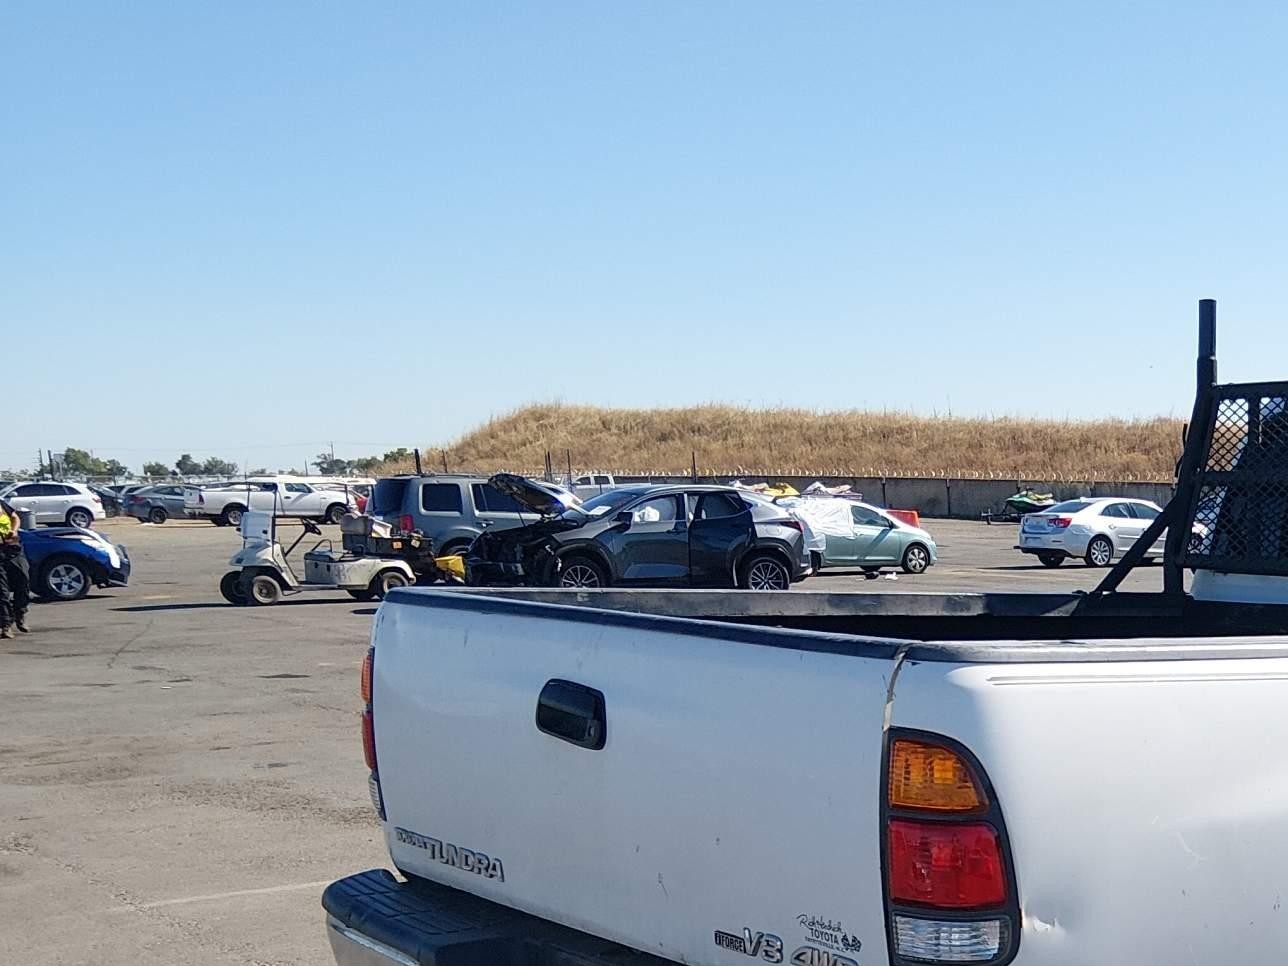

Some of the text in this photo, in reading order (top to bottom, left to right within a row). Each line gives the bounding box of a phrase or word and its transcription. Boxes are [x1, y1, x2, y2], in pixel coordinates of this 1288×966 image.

[428, 837, 505, 882] TUNDRA
[743, 926, 784, 964] V8
[809, 927, 840, 946] TOYOTA
